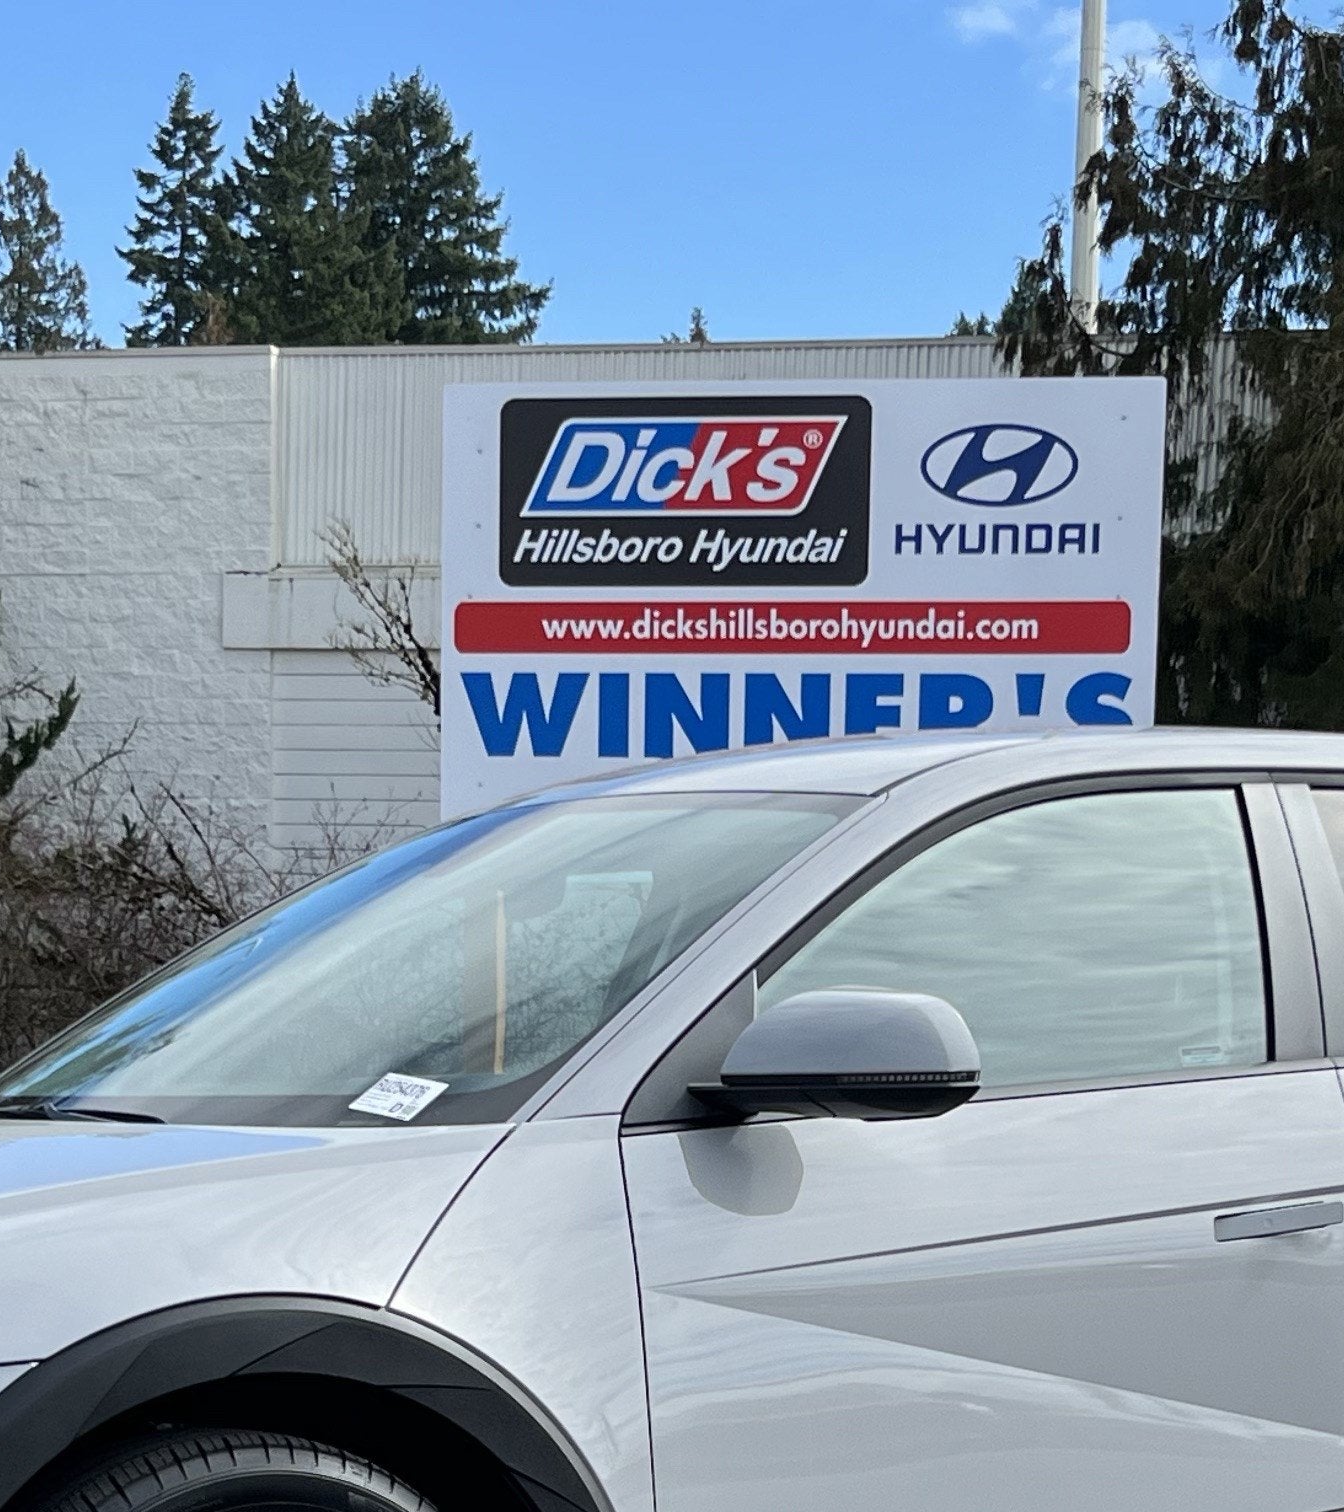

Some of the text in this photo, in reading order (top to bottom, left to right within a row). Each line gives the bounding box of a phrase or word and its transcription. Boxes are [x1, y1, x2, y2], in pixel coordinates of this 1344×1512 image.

[546, 426, 806, 504] Dick's
[513, 527, 849, 572] Hillsboro Hyundai
[894, 522, 1101, 556] HYUNDAI
[541, 609, 1039, 648] www.dickshillsborohyundai.com
